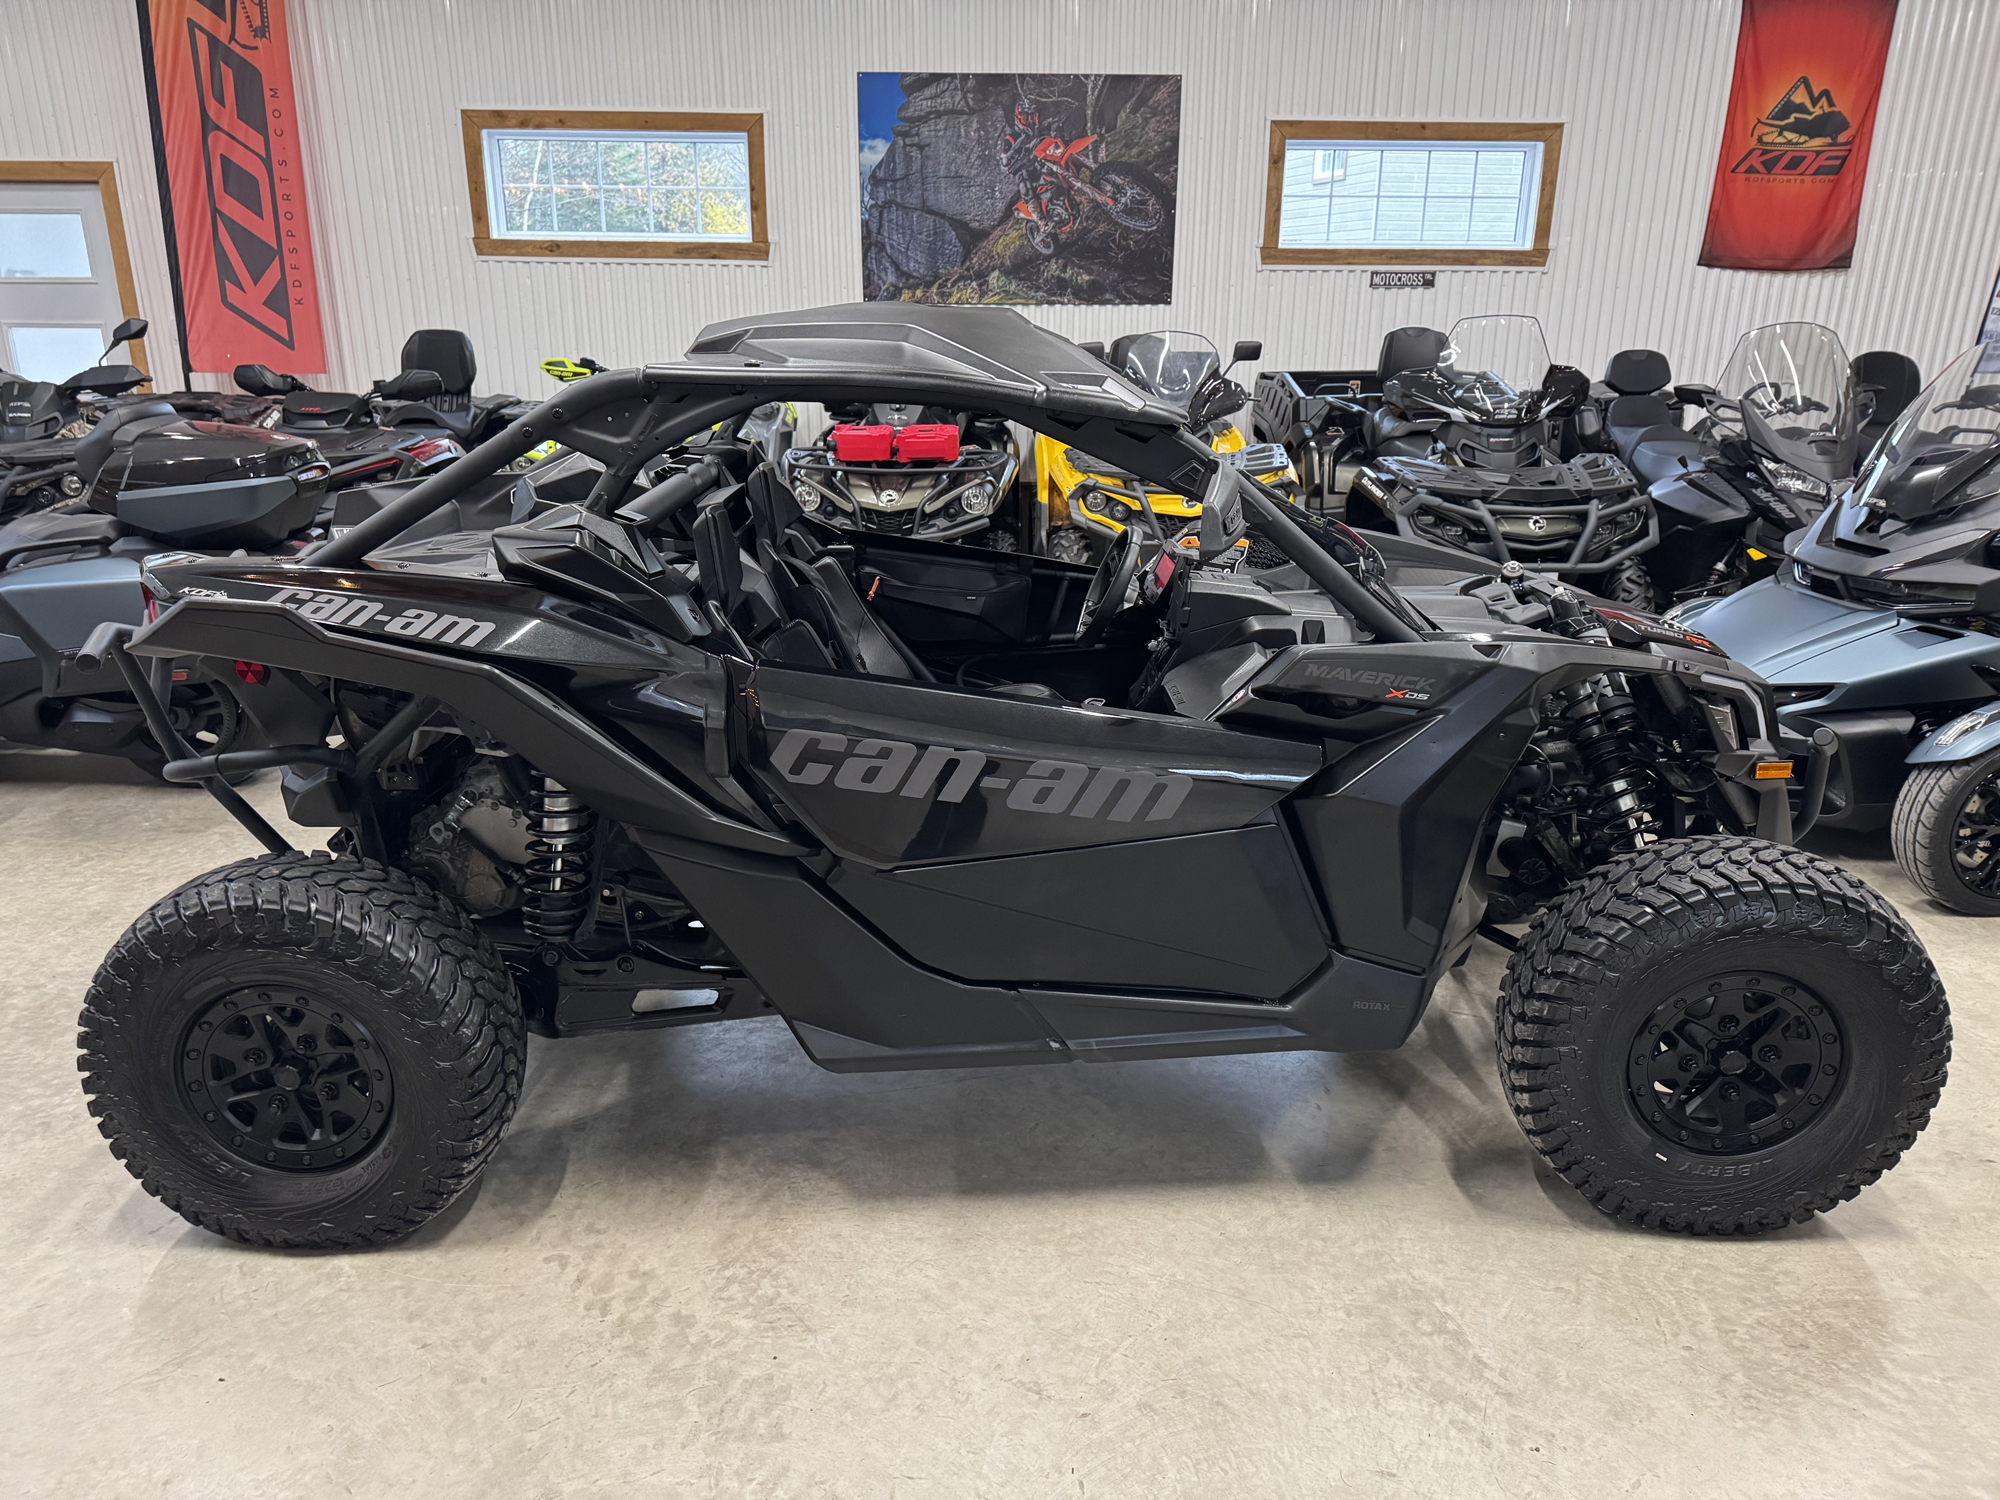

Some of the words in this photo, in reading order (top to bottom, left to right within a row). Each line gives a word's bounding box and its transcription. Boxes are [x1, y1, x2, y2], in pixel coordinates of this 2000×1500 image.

[1733, 149, 1850, 175] KDF
[191, 22, 292, 346] KDF
[269, 87, 305, 306] KDFSPORTS.COM
[1372, 273, 1423, 285] MOTOCROSS
[266, 588, 497, 648] can-am
[1638, 624, 1684, 639] TURBO
[1304, 663, 1438, 692] MAVERICK
[769, 728, 1194, 823] can-am
[1352, 1001, 1391, 1011] ROTAX
[1678, 1158, 1774, 1178] LIBERTY
